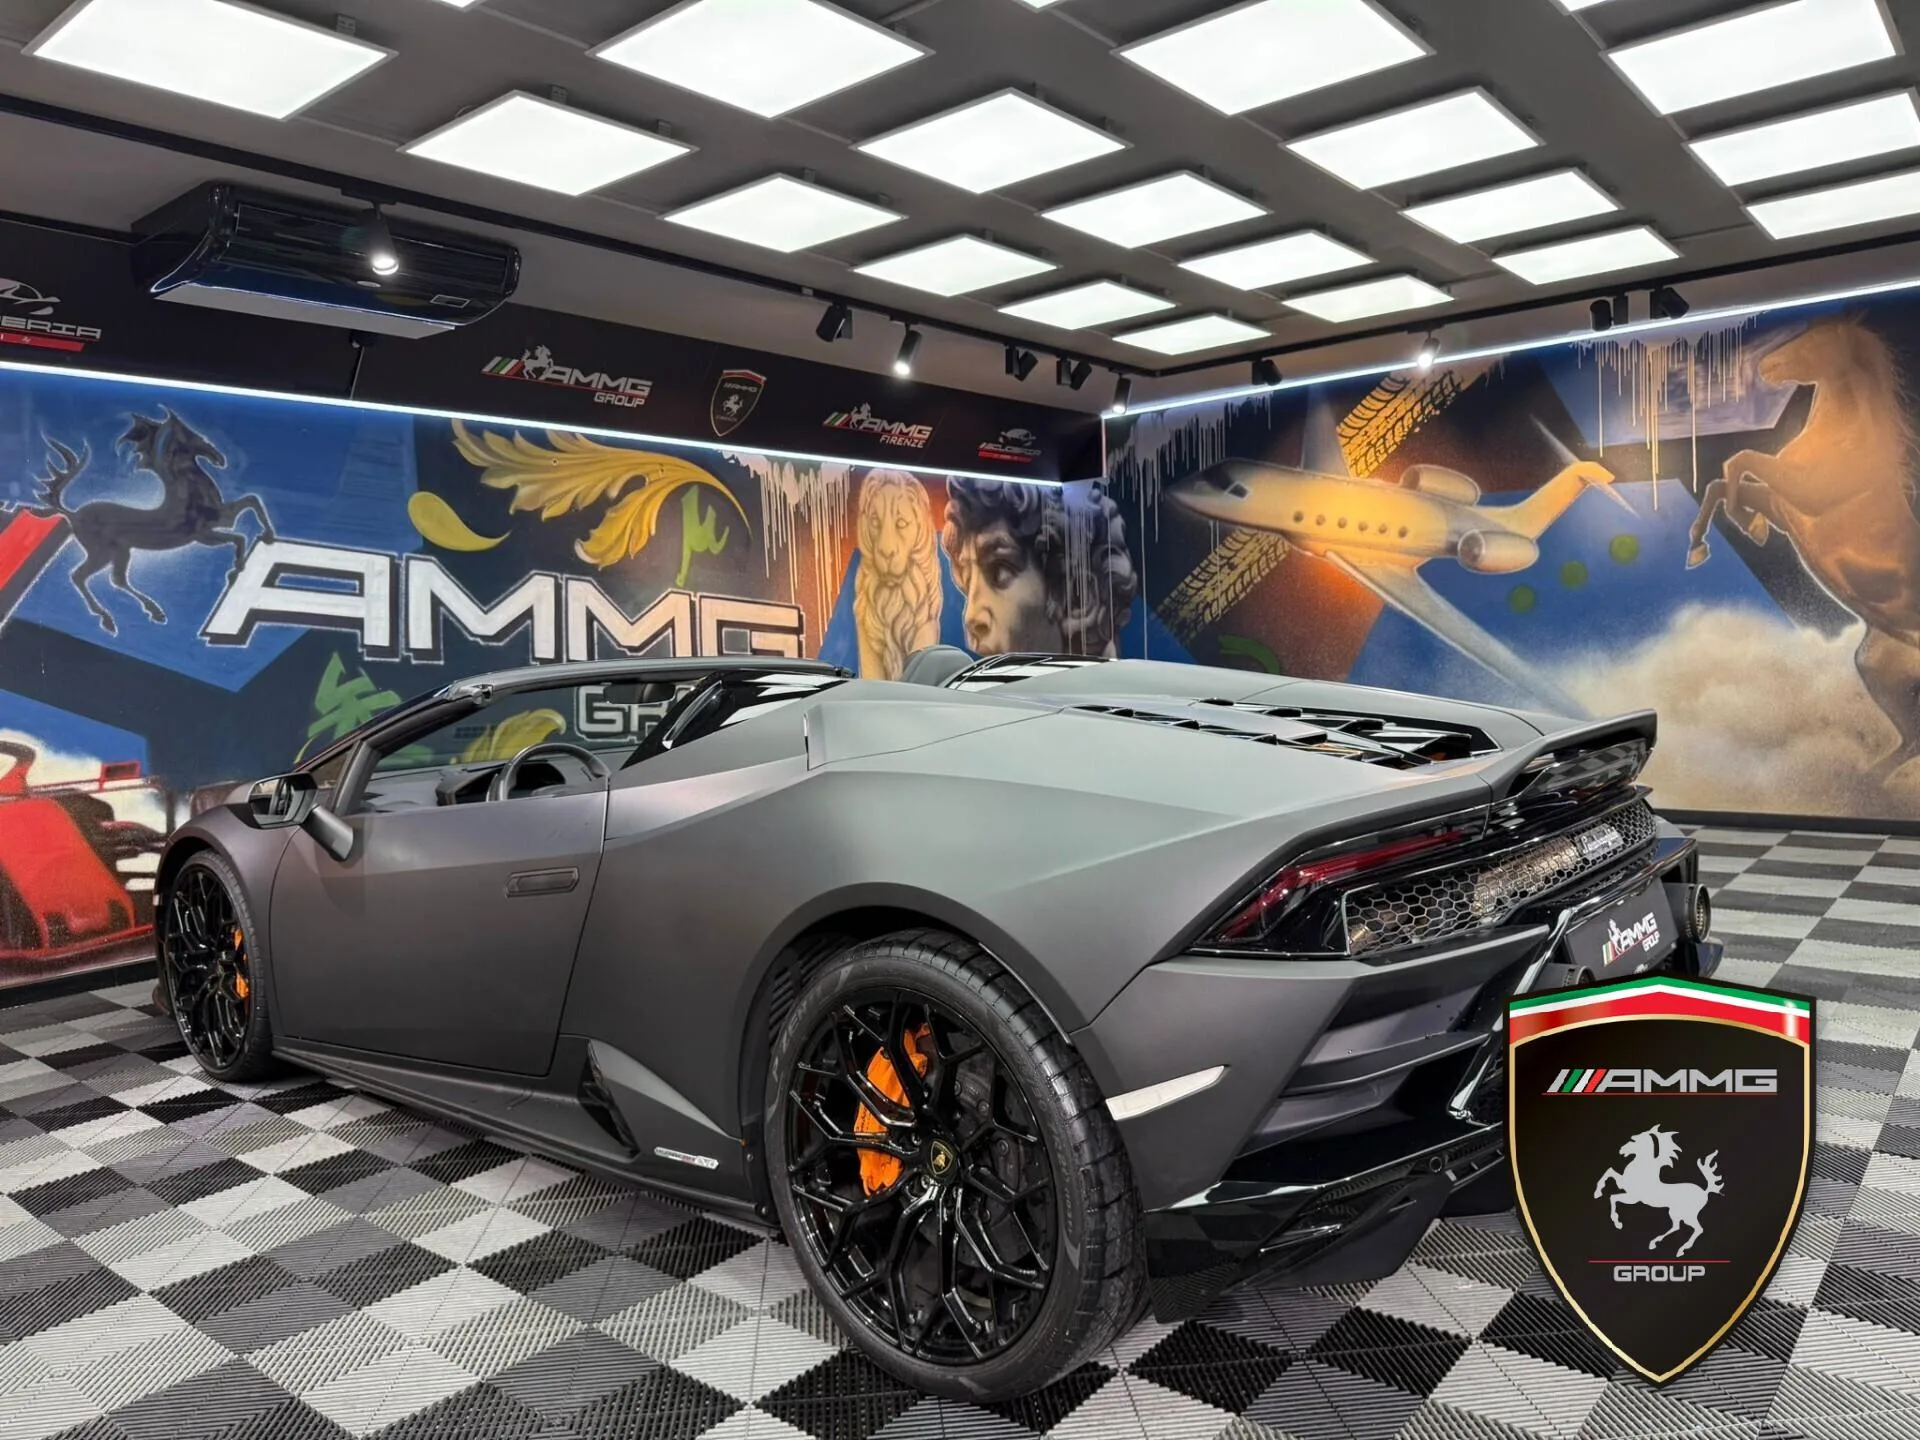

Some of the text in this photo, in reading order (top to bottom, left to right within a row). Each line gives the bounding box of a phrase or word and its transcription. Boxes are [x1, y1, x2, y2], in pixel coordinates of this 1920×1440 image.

[0, 315, 102, 339] ERIA
[540, 366, 652, 397] AMMG
[593, 391, 645, 408] GROUP
[860, 418, 933, 439] AMMG
[879, 434, 927, 449] FIRENZE
[204, 540, 804, 660] AMMG
